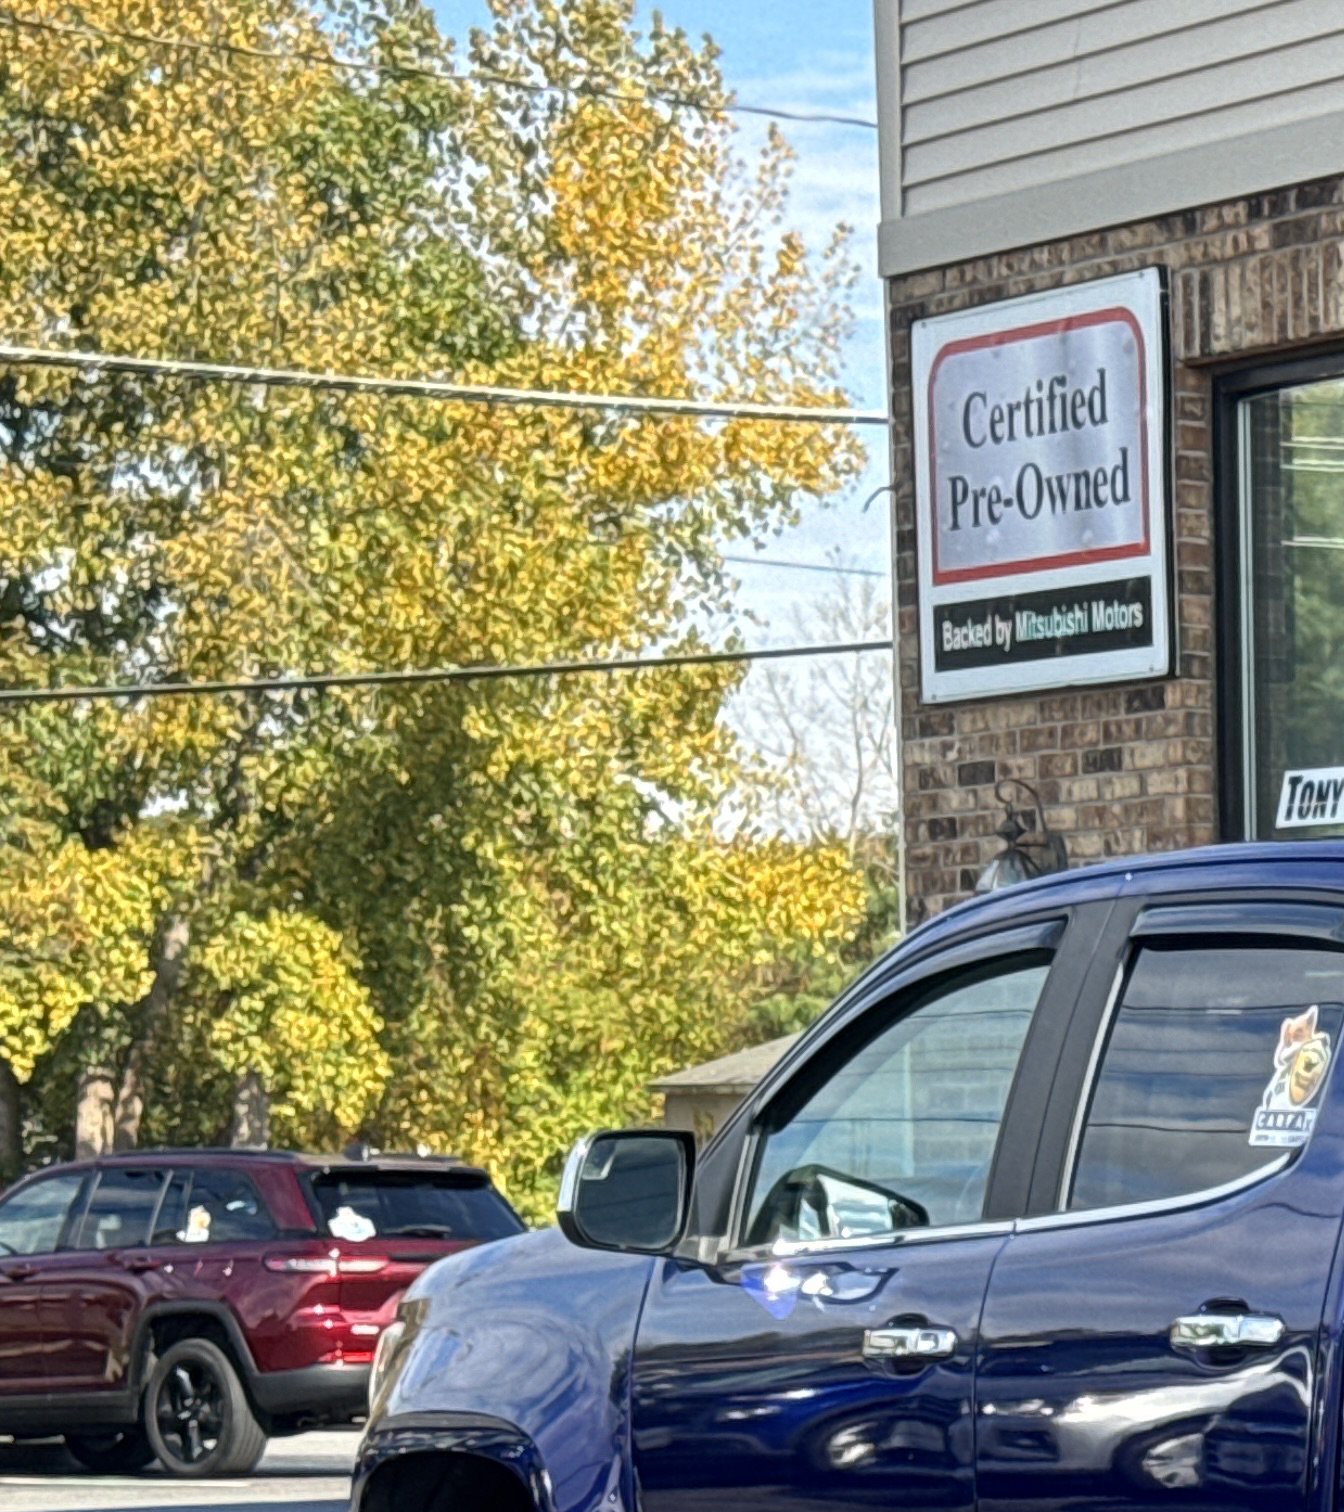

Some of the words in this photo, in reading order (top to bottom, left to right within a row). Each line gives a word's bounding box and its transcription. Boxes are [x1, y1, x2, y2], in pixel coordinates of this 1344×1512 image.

[962, 367, 1109, 449] Certified
[947, 446, 1131, 532] Pre-Owned
[941, 614, 994, 652] Backed
[994, 613, 1013, 653] by
[1014, 602, 1089, 643] Mitsubishi
[1091, 599, 1144, 633] Motors
